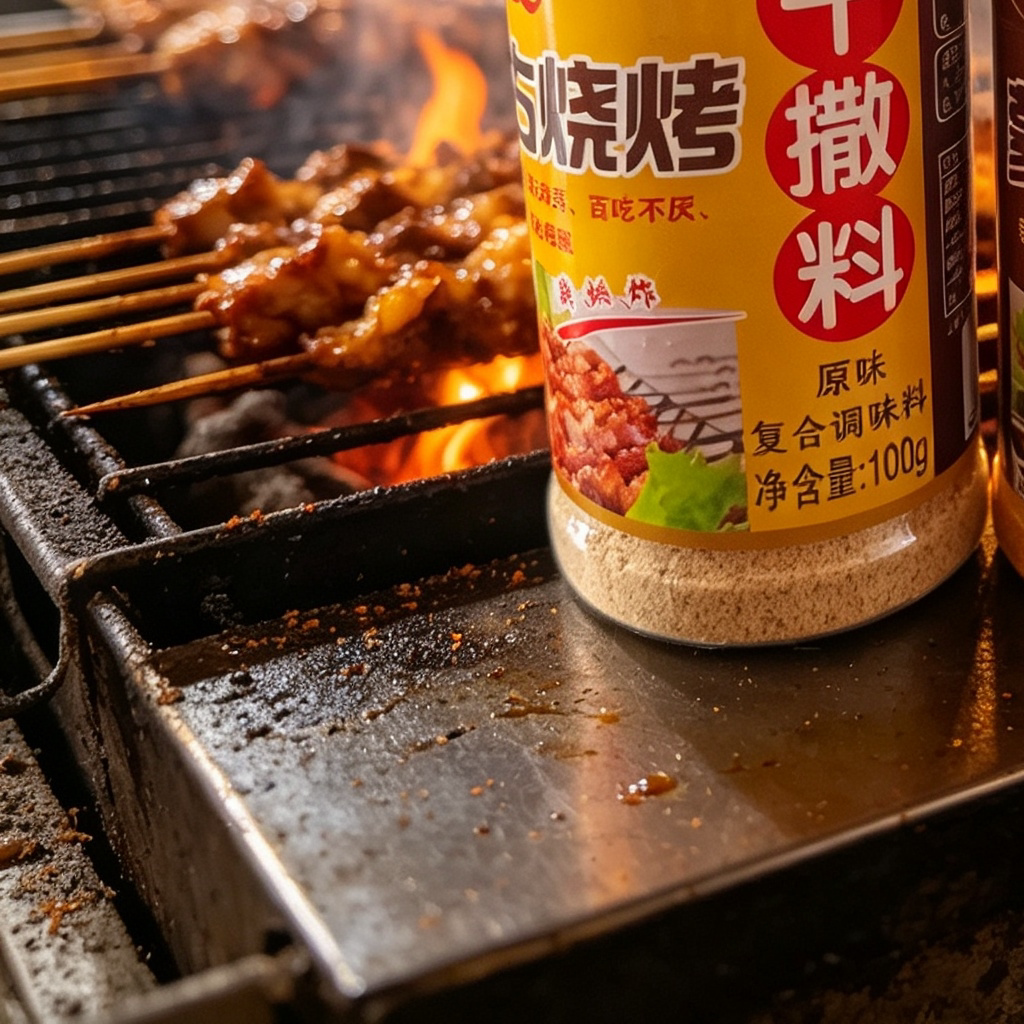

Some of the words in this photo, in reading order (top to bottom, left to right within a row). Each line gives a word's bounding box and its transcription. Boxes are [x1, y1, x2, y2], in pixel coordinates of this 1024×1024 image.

[816, 349, 887, 398] 原味
[751, 378, 928, 457] 复合调味料
